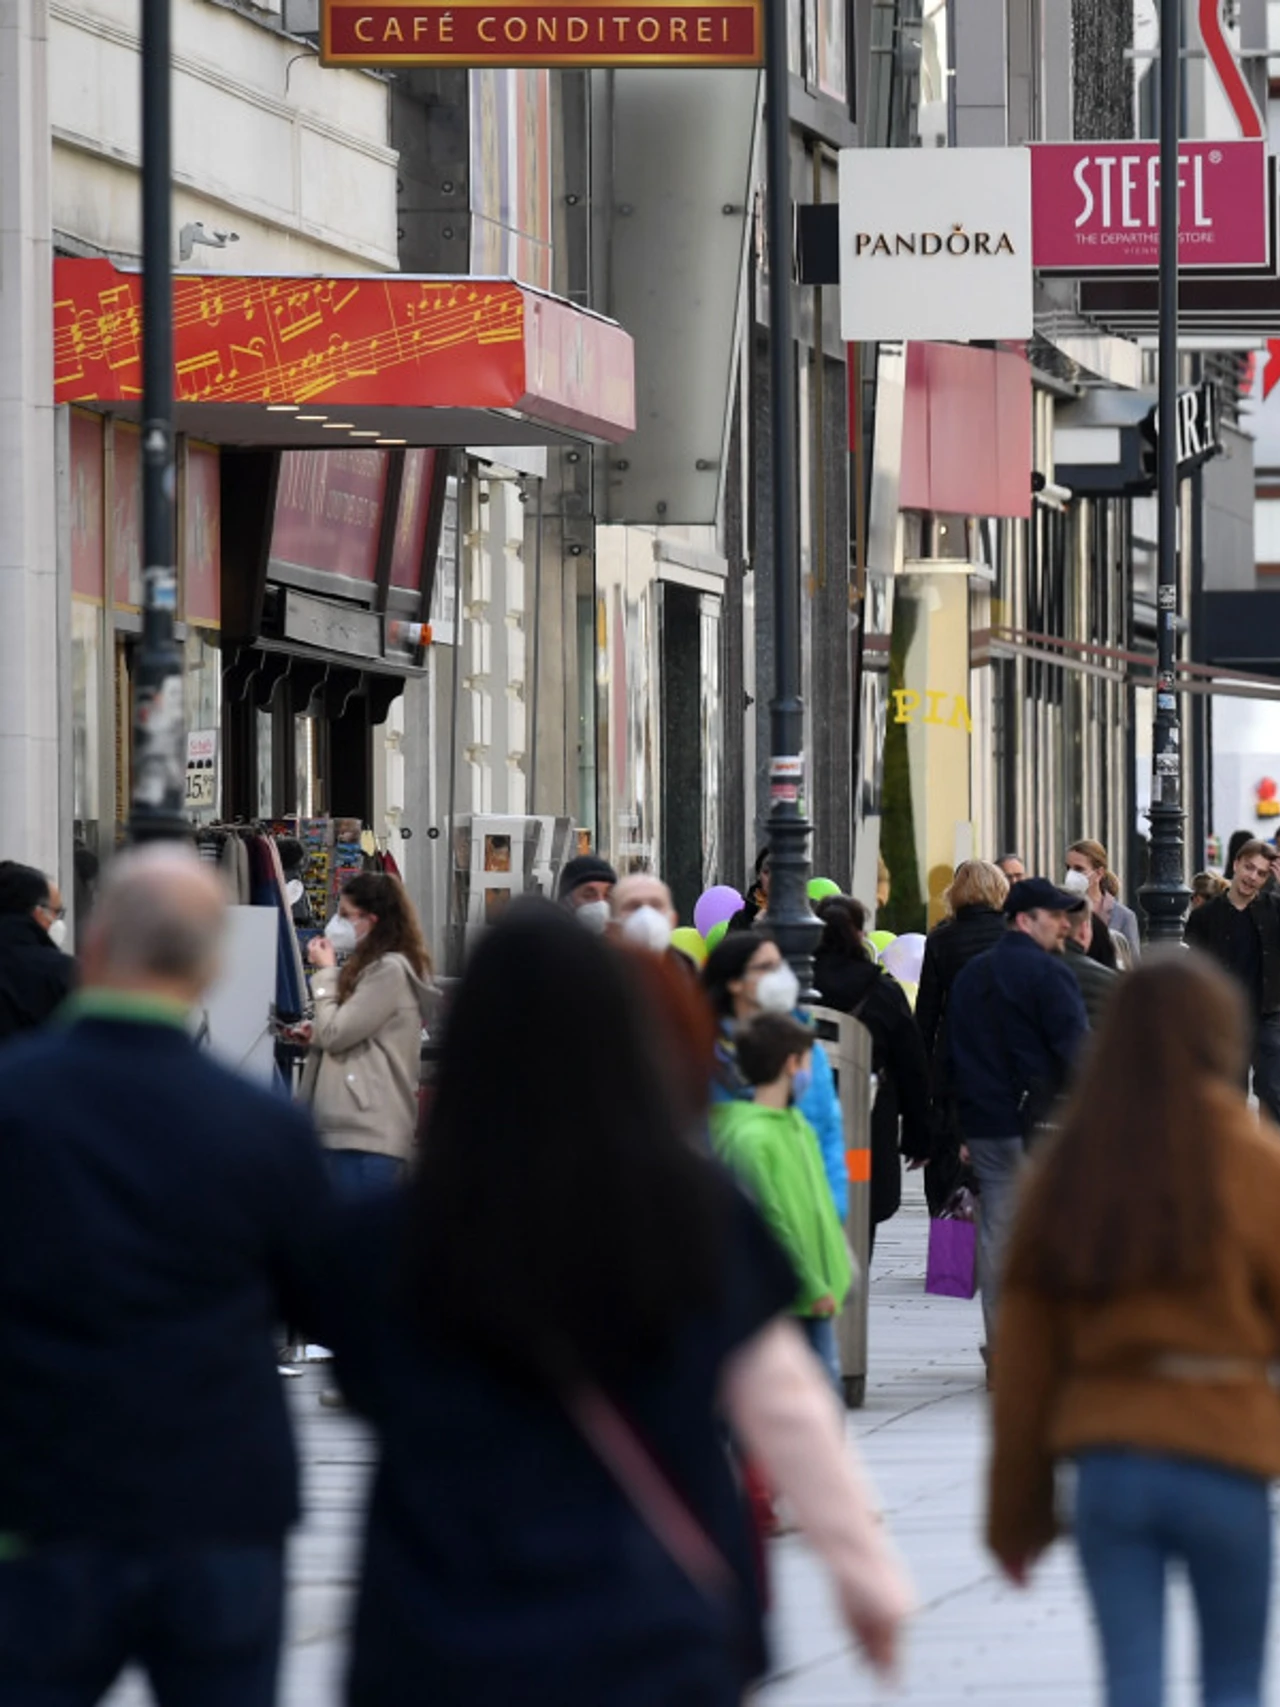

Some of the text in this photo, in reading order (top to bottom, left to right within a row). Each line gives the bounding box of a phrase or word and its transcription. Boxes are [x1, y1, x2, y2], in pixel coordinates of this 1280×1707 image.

[354, 13, 729, 42] CAFÉ CONDITOREI
[855, 226, 1015, 256] PANDORA
[1075, 232, 1098, 245] THE
[1100, 232, 1161, 245] DEPARTME
[1123, 246, 1160, 255] VIENN
